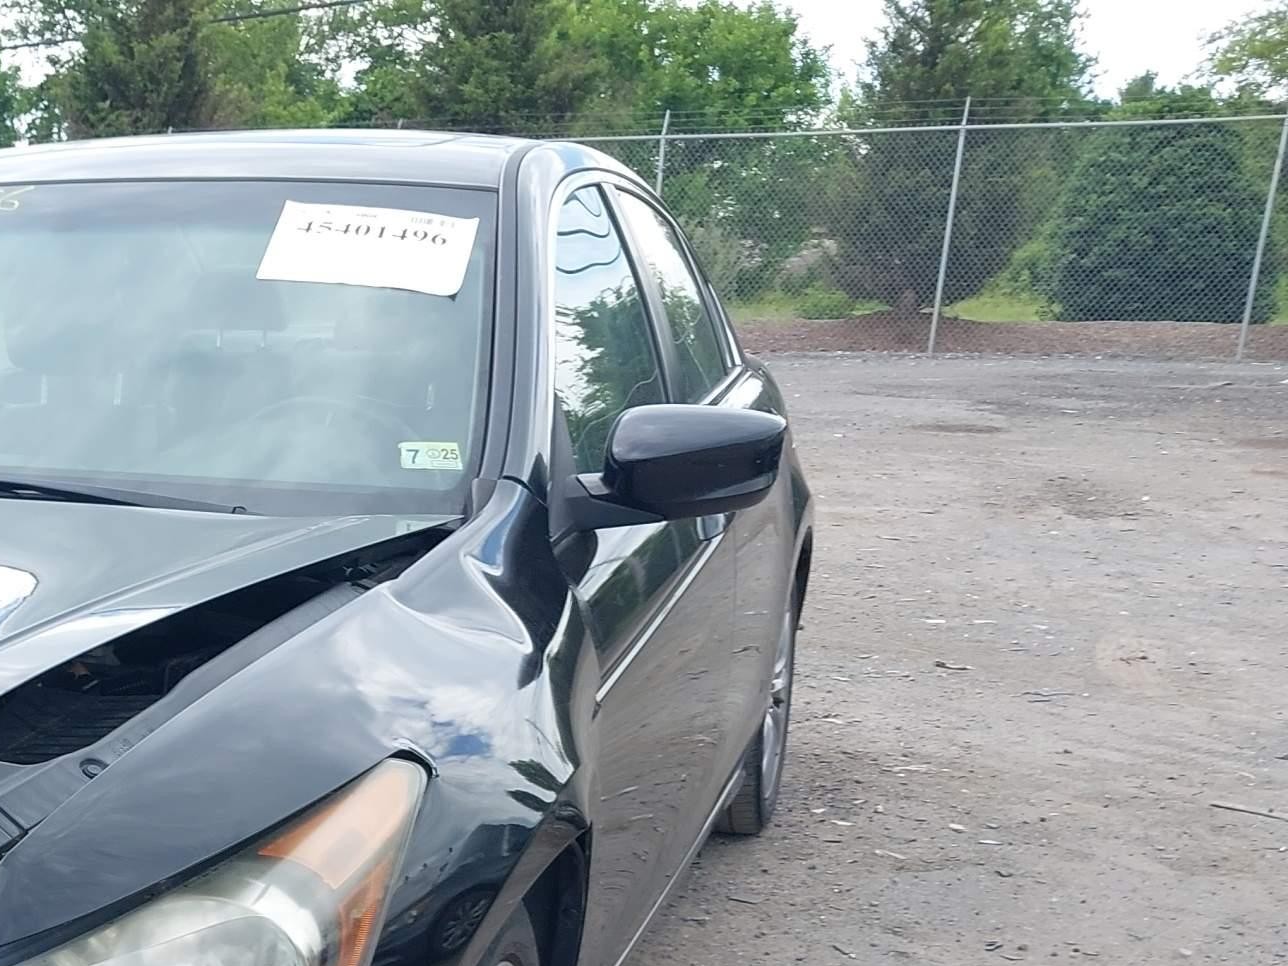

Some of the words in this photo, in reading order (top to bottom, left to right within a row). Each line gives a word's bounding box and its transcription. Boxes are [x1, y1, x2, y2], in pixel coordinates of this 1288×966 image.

[297, 220, 448, 247] 45401496
[405, 449, 420, 465] 7
[440, 448, 459, 460] 25
